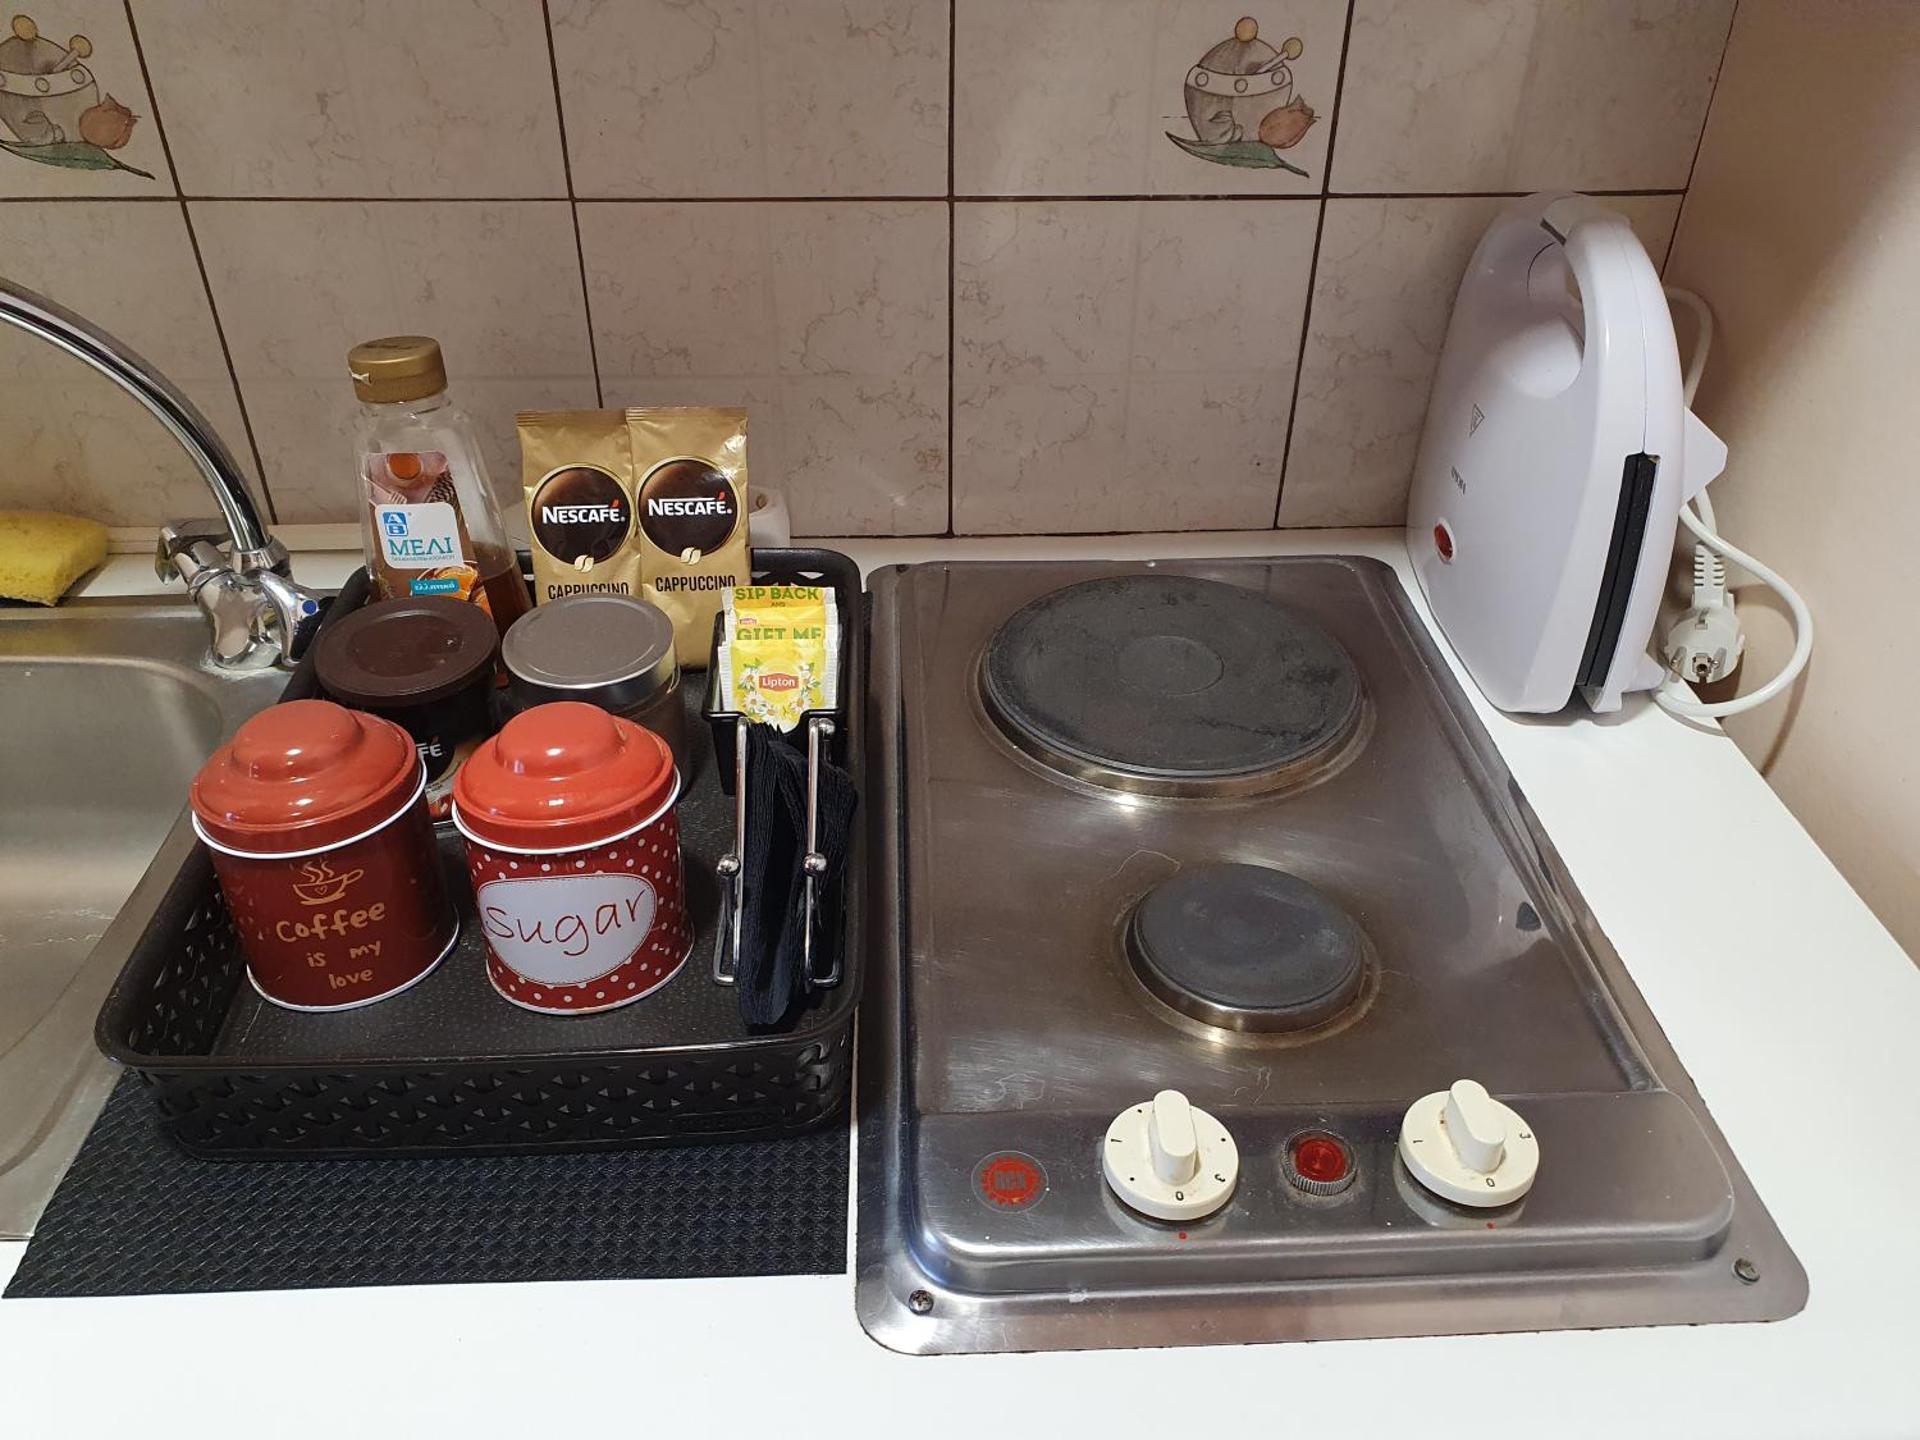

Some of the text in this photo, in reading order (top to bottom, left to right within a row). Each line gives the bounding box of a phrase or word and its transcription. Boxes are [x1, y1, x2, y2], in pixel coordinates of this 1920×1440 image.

[655, 575, 736, 592] CAPPUCCINO
[735, 587, 819, 600] SIP BACK
[762, 676, 796, 689] Lipton
[276, 902, 386, 942] Coffee
[306, 940, 381, 968] is my
[328, 969, 373, 989] love
